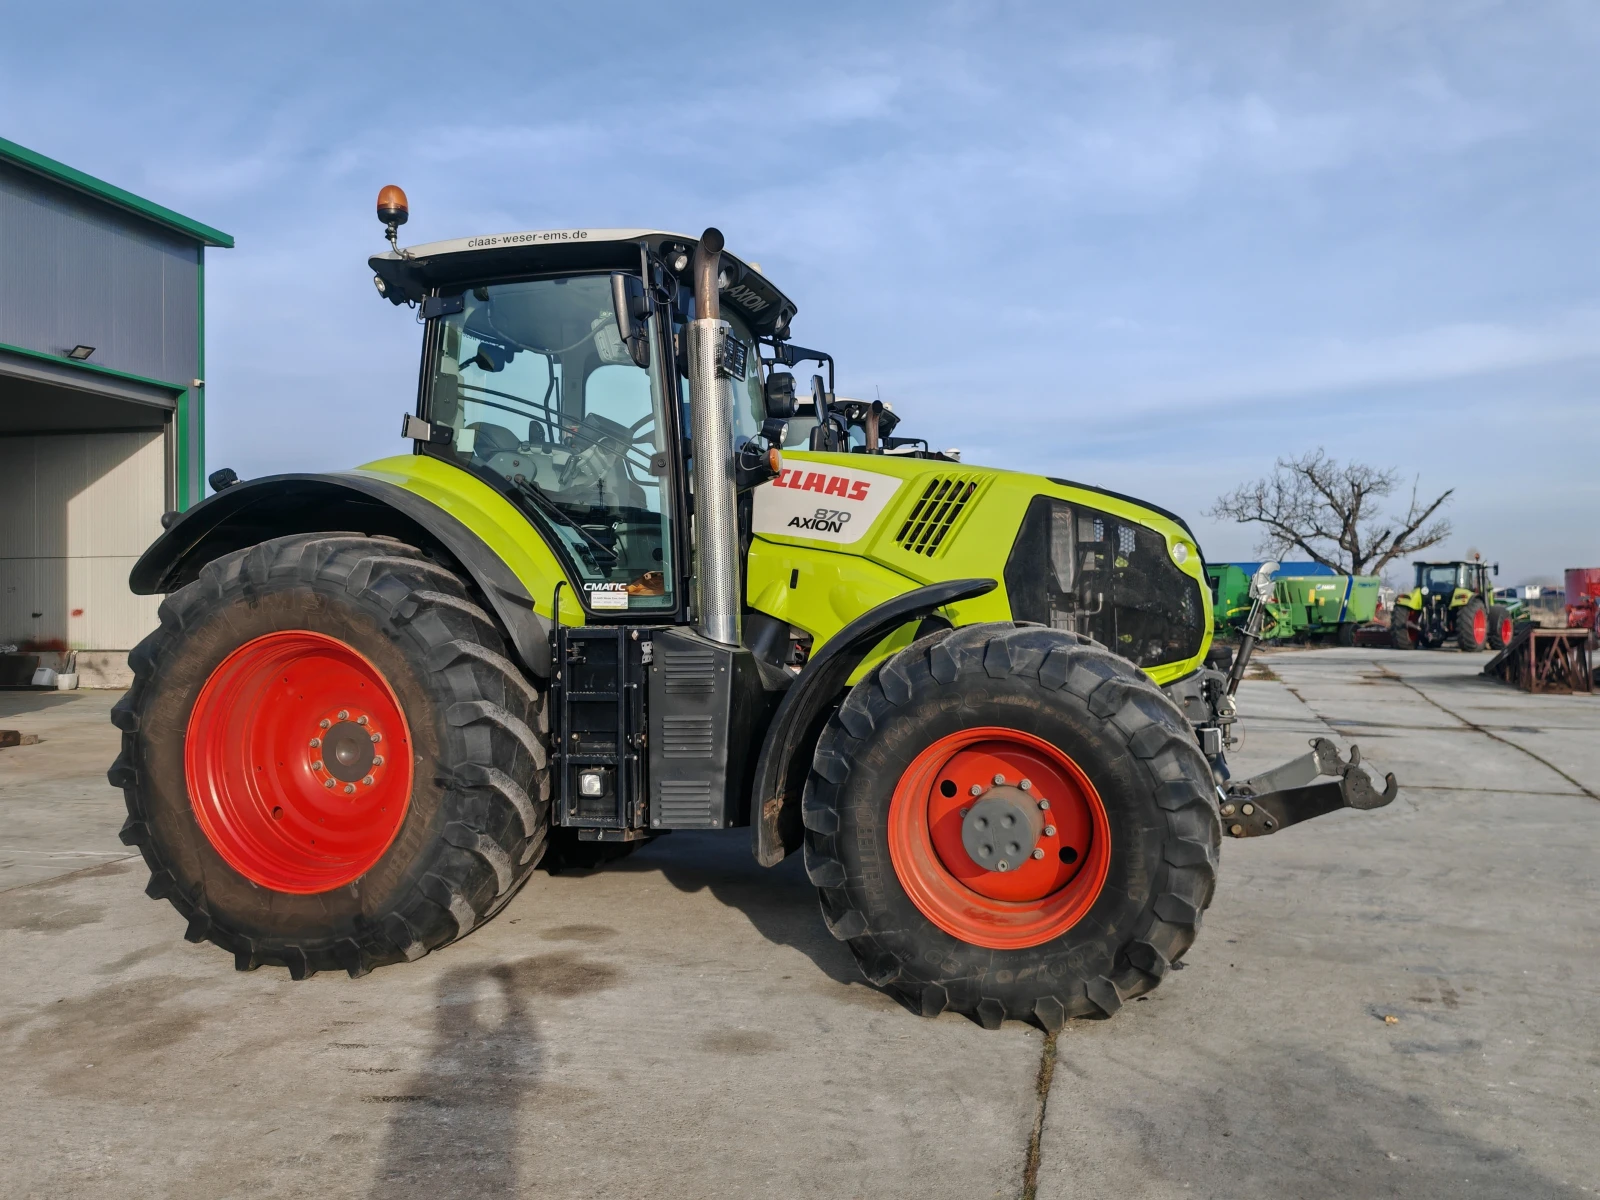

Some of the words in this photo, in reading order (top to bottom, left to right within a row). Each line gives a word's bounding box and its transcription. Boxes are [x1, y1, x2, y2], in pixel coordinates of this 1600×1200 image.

[468, 230, 588, 248] claas-weser-ems.de
[725, 284, 770, 313] AXION
[772, 468, 871, 501] CLAAS
[787, 516, 843, 533] AXION
[814, 508, 852, 523] 870
[583, 582, 627, 591] CMATIC
[853, 778, 888, 916] TRELLEBORG
